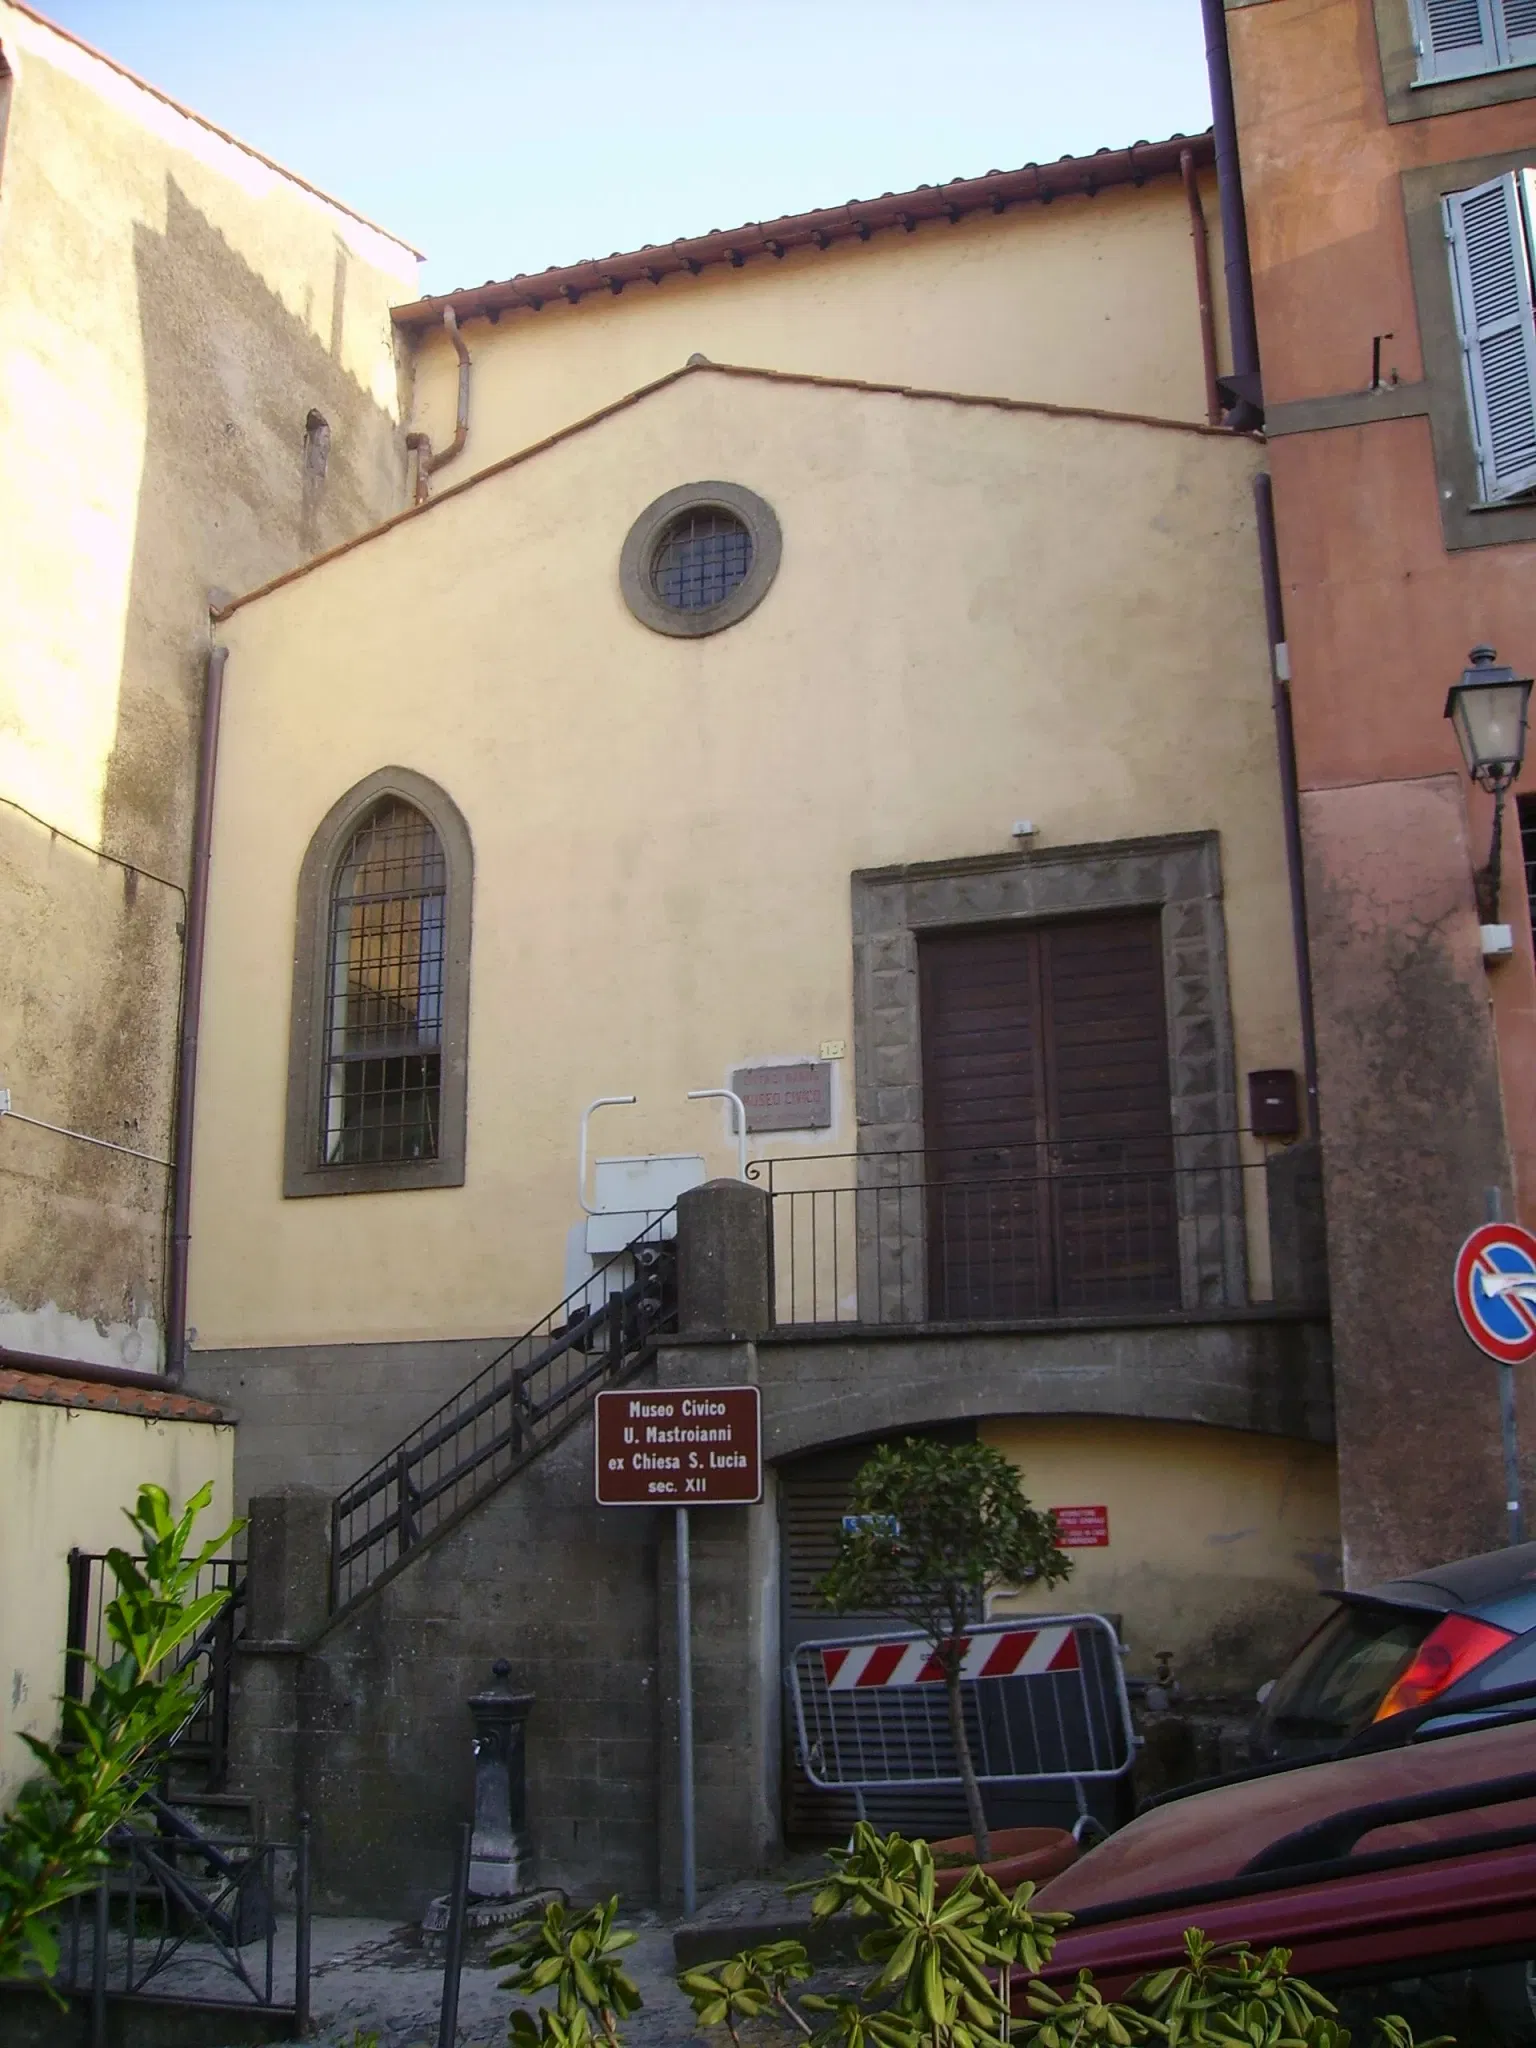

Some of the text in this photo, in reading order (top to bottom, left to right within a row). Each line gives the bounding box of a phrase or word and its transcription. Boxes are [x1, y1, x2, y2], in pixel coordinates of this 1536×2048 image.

[742, 1089, 821, 1107] MUSEO CIVICO
[629, 1398, 726, 1418] Museo Civico
[623, 1424, 732, 1444] U. Mastroianni
[608, 1450, 747, 1470] ex Chiesa S. Lucia
[648, 1477, 706, 1493] sec. XII
